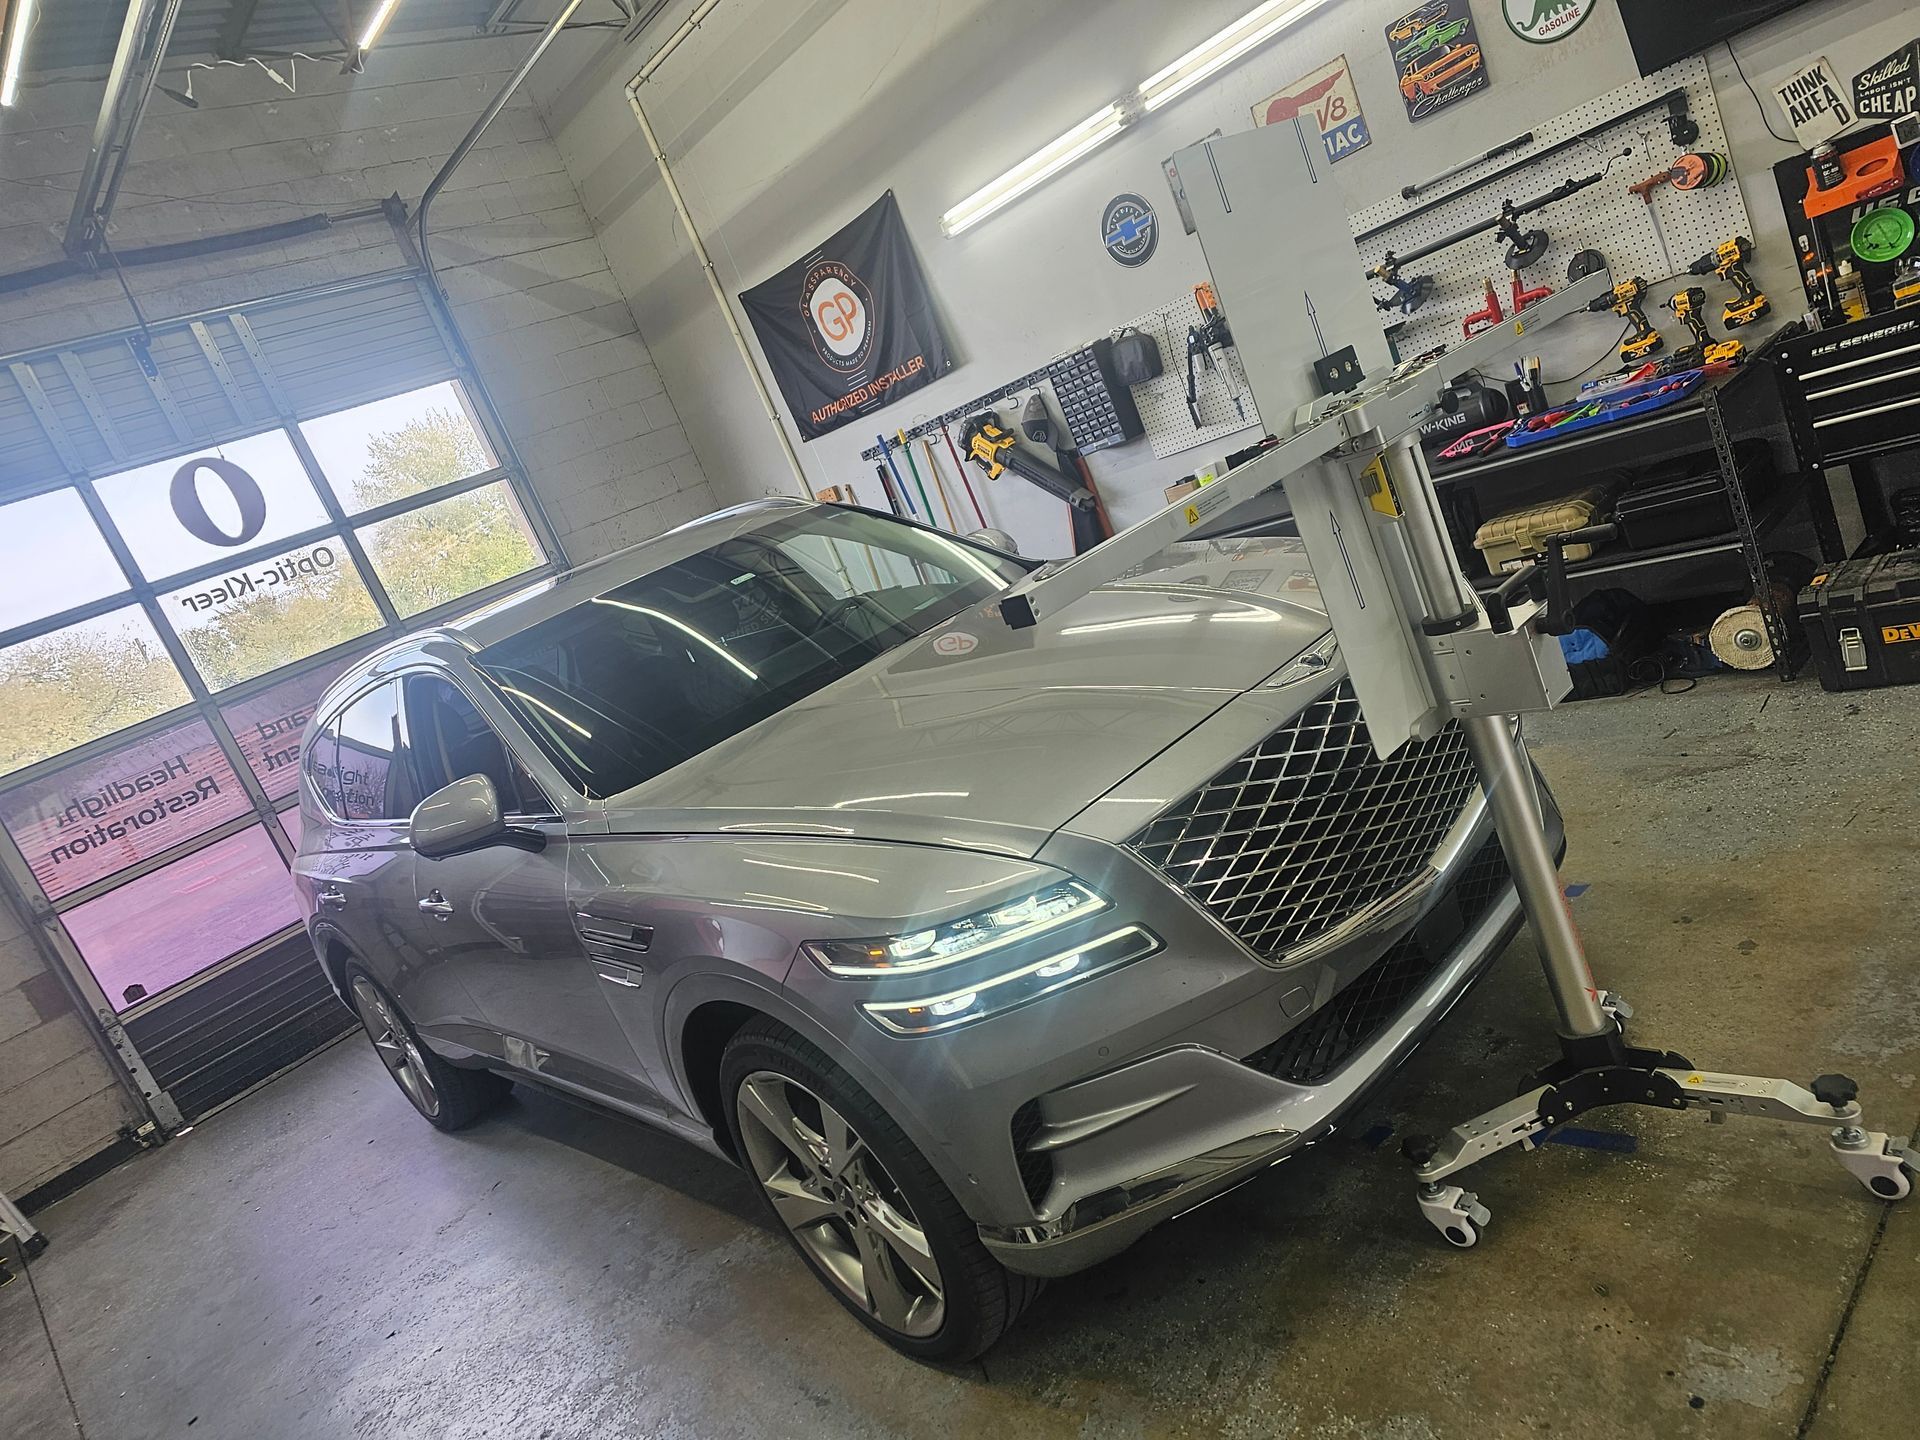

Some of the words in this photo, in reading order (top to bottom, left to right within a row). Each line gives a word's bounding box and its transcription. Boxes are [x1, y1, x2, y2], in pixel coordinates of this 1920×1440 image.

[1538, 7, 1580, 36] GASOLINE
[1777, 65, 1829, 106] THINK
[1857, 53, 1911, 91] Skilled
[1859, 85, 1887, 98] LABOR
[1889, 77, 1912, 89] ISN'T
[1315, 95, 1348, 132] V8
[1411, 76, 1484, 118] Challenger
[1788, 83, 1841, 128] AHEA
[1832, 102, 1851, 127] D
[1859, 86, 1917, 114] CHEAP
[802, 266, 856, 317] GLASSPARENCY
[818, 292, 857, 341] GP
[822, 347, 845, 366] PRODUCTS
[846, 358, 858, 366] MADE
[858, 351, 864, 359] TO
[811, 388, 869, 424] AUTHORIZED
[867, 355, 926, 396] INSTALLER
[1420, 413, 1467, 435] W-KING
